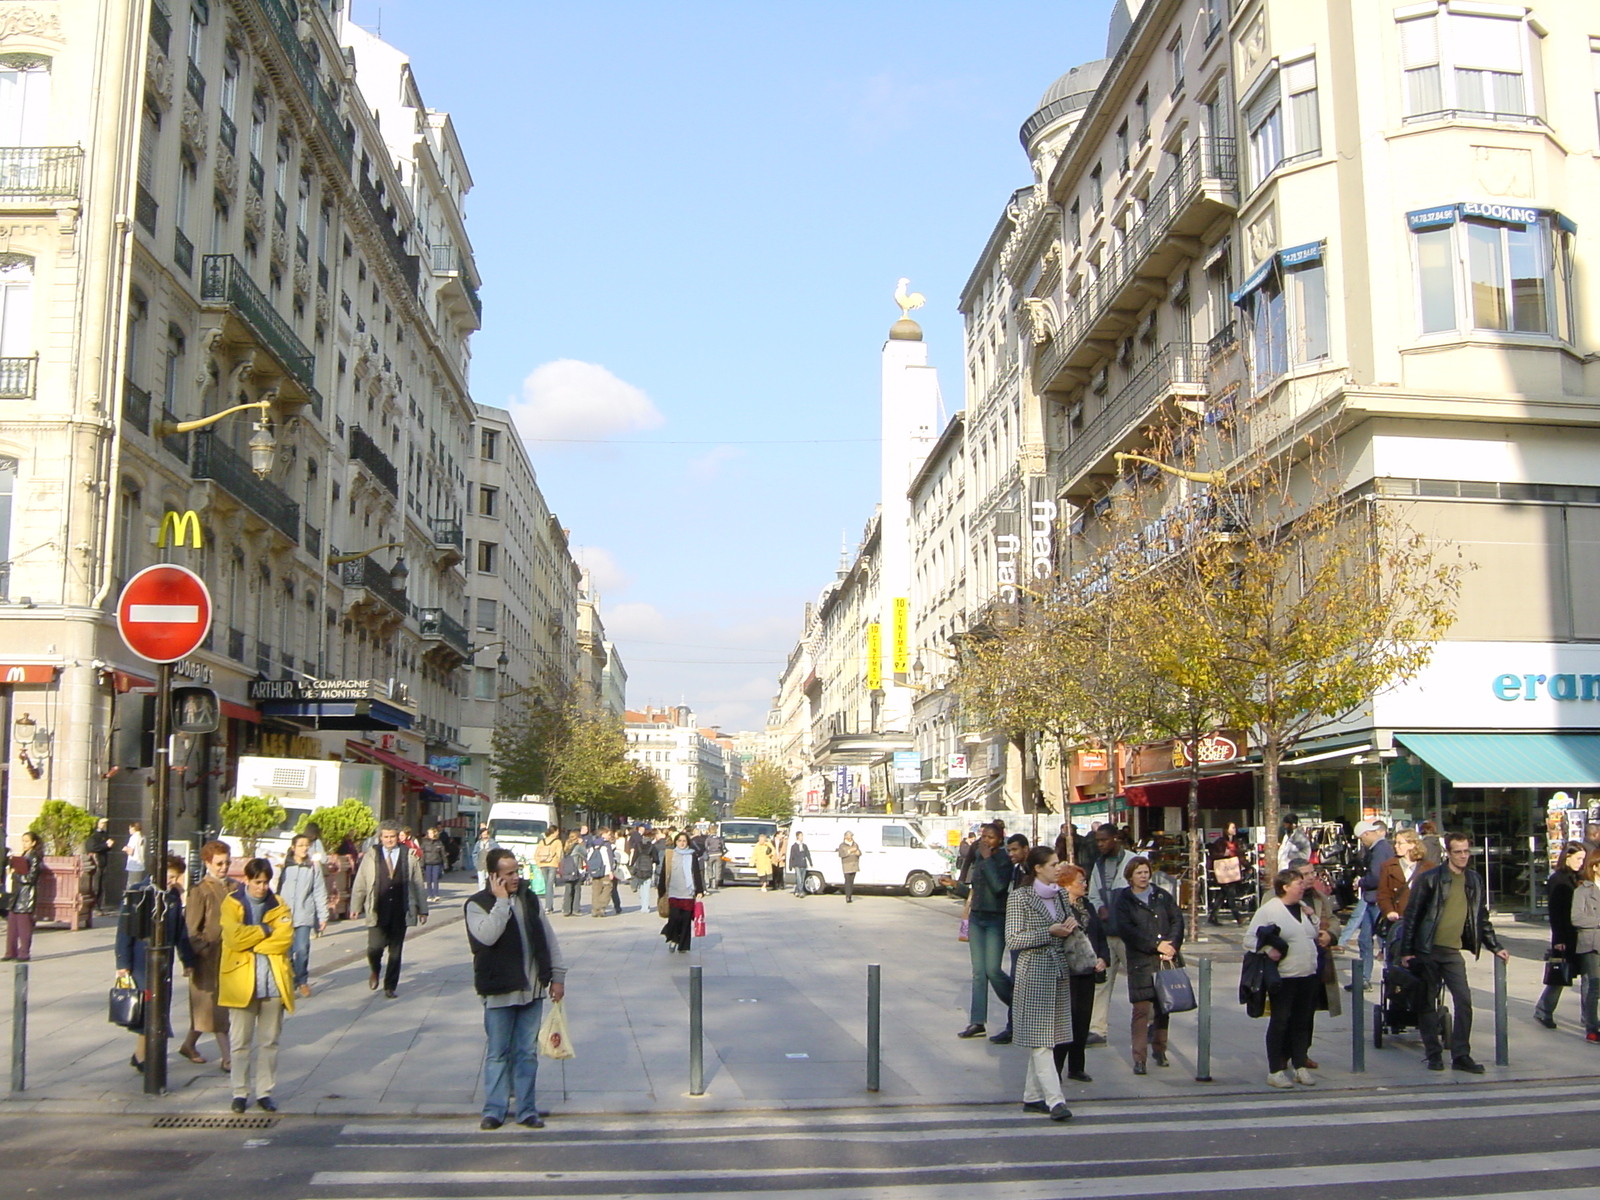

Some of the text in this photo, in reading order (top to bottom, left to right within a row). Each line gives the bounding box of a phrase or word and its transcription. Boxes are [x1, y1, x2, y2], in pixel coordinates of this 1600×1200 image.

[1031, 499, 1058, 580] fnac
[997, 533, 1021, 605] fnac
[896, 599, 905, 608] 10
[252, 681, 294, 699] ARTHUR
[299, 679, 370, 690] LA COMPAGNIE
[301, 689, 368, 699] DES MONTRES
